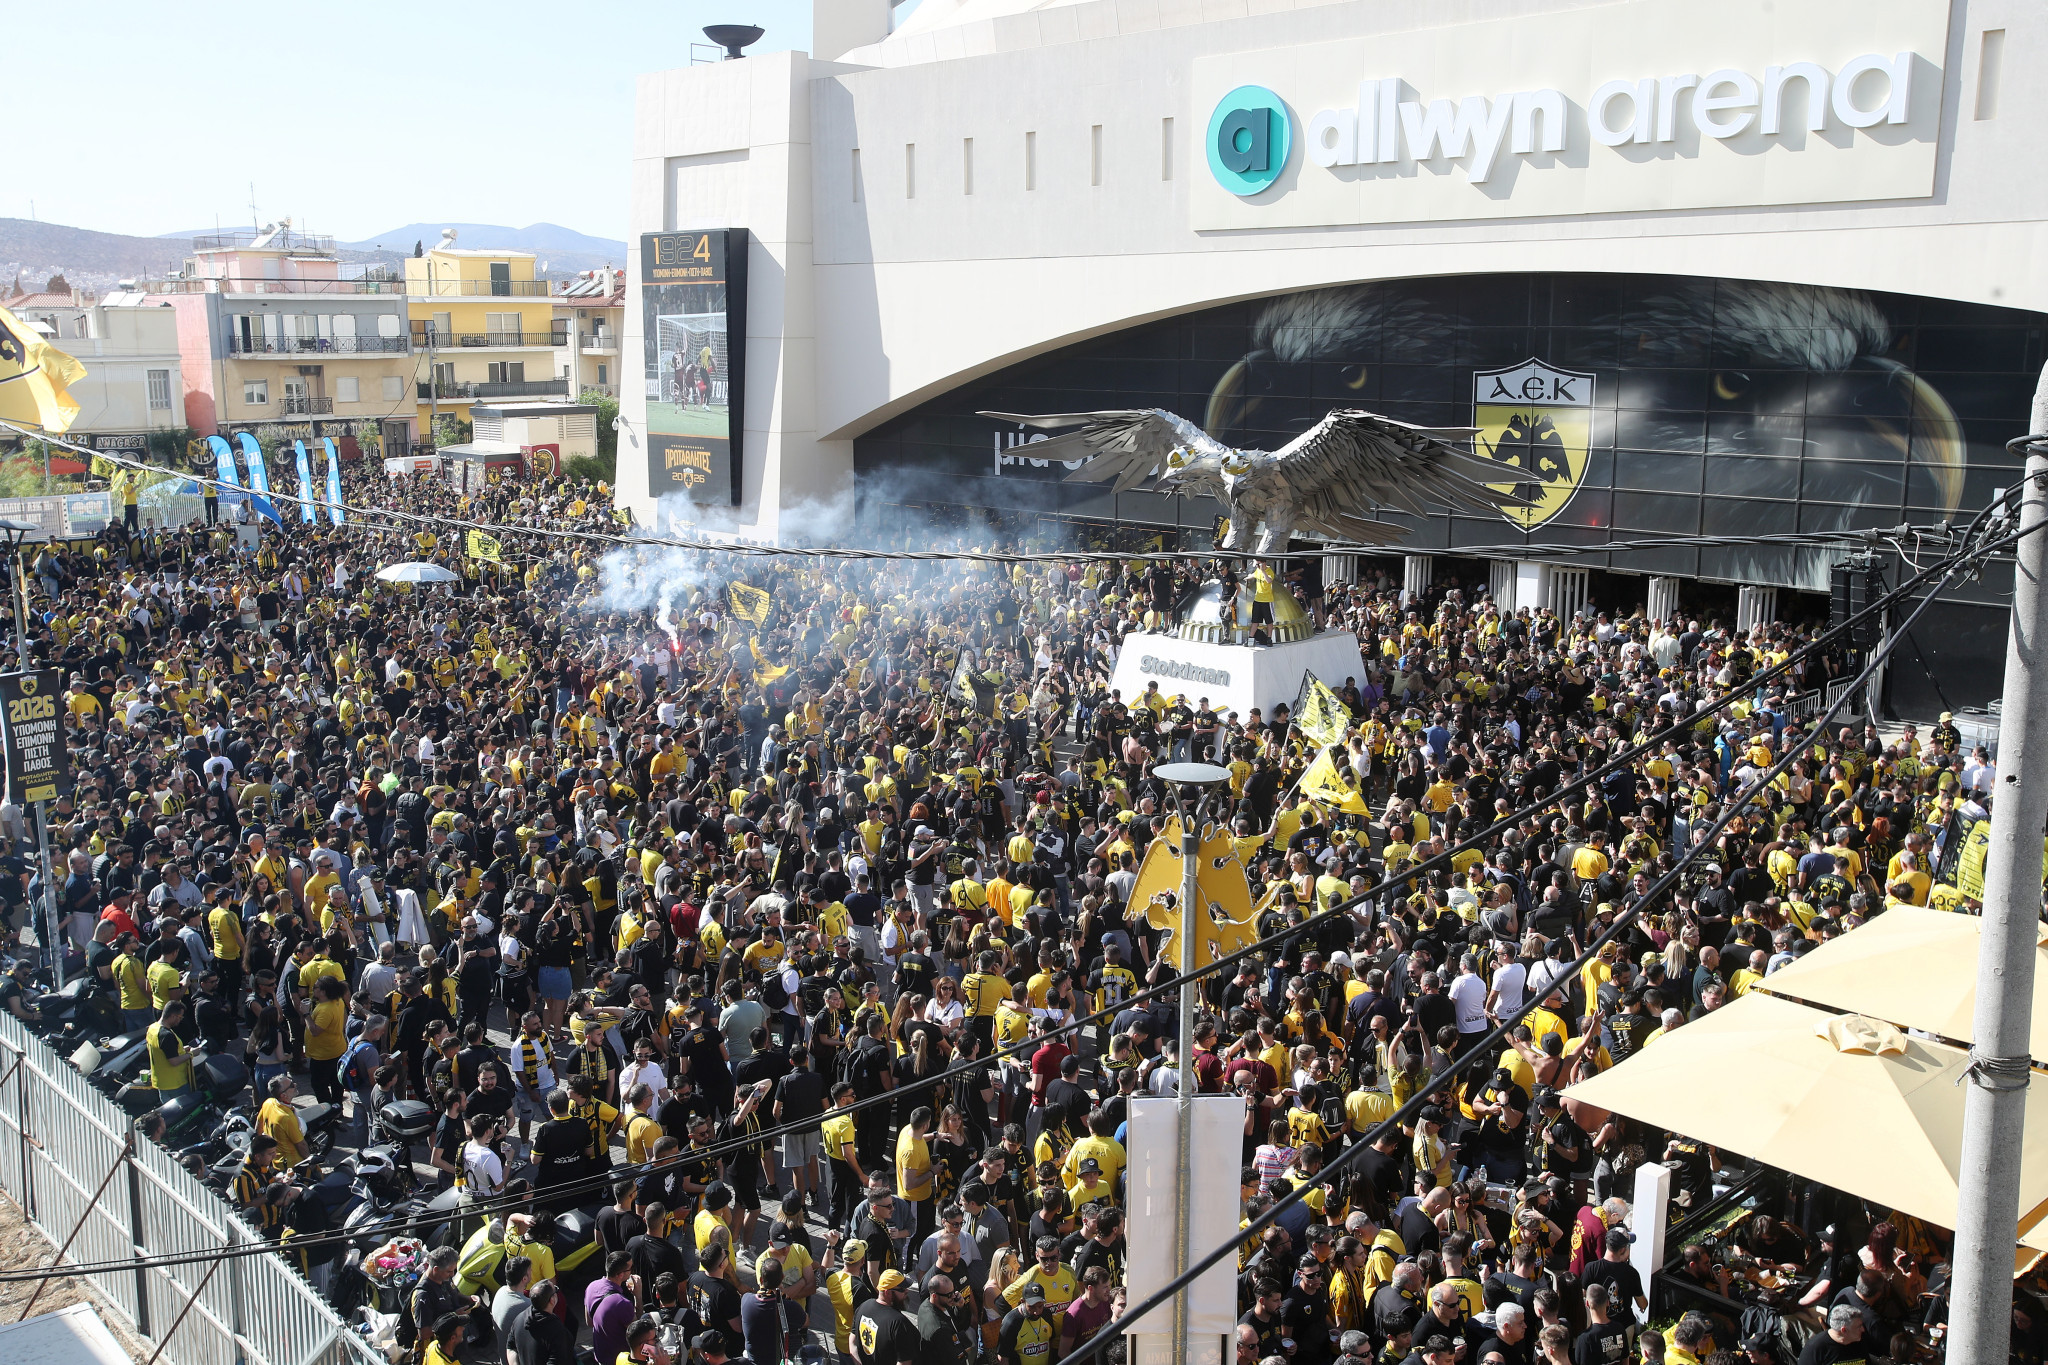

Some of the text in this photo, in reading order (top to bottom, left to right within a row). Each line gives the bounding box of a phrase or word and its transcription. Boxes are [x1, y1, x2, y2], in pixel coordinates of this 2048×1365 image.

[1307, 51, 1916, 183] allwyn arena
[653, 234, 711, 265] 1924
[1140, 654, 1231, 687] Stoiximan
[8, 694, 56, 723] 2026
[12, 719, 57, 738] ΥΠΟΜΟΝΗ
[16, 732, 56, 750] ΕΠΙΜΟΝΗ
[24, 745, 50, 760] ΠΙΣΤΗ
[23, 757, 53, 773] ΠΑΘΟΣ
[1105, 983, 1123, 1006] 11
